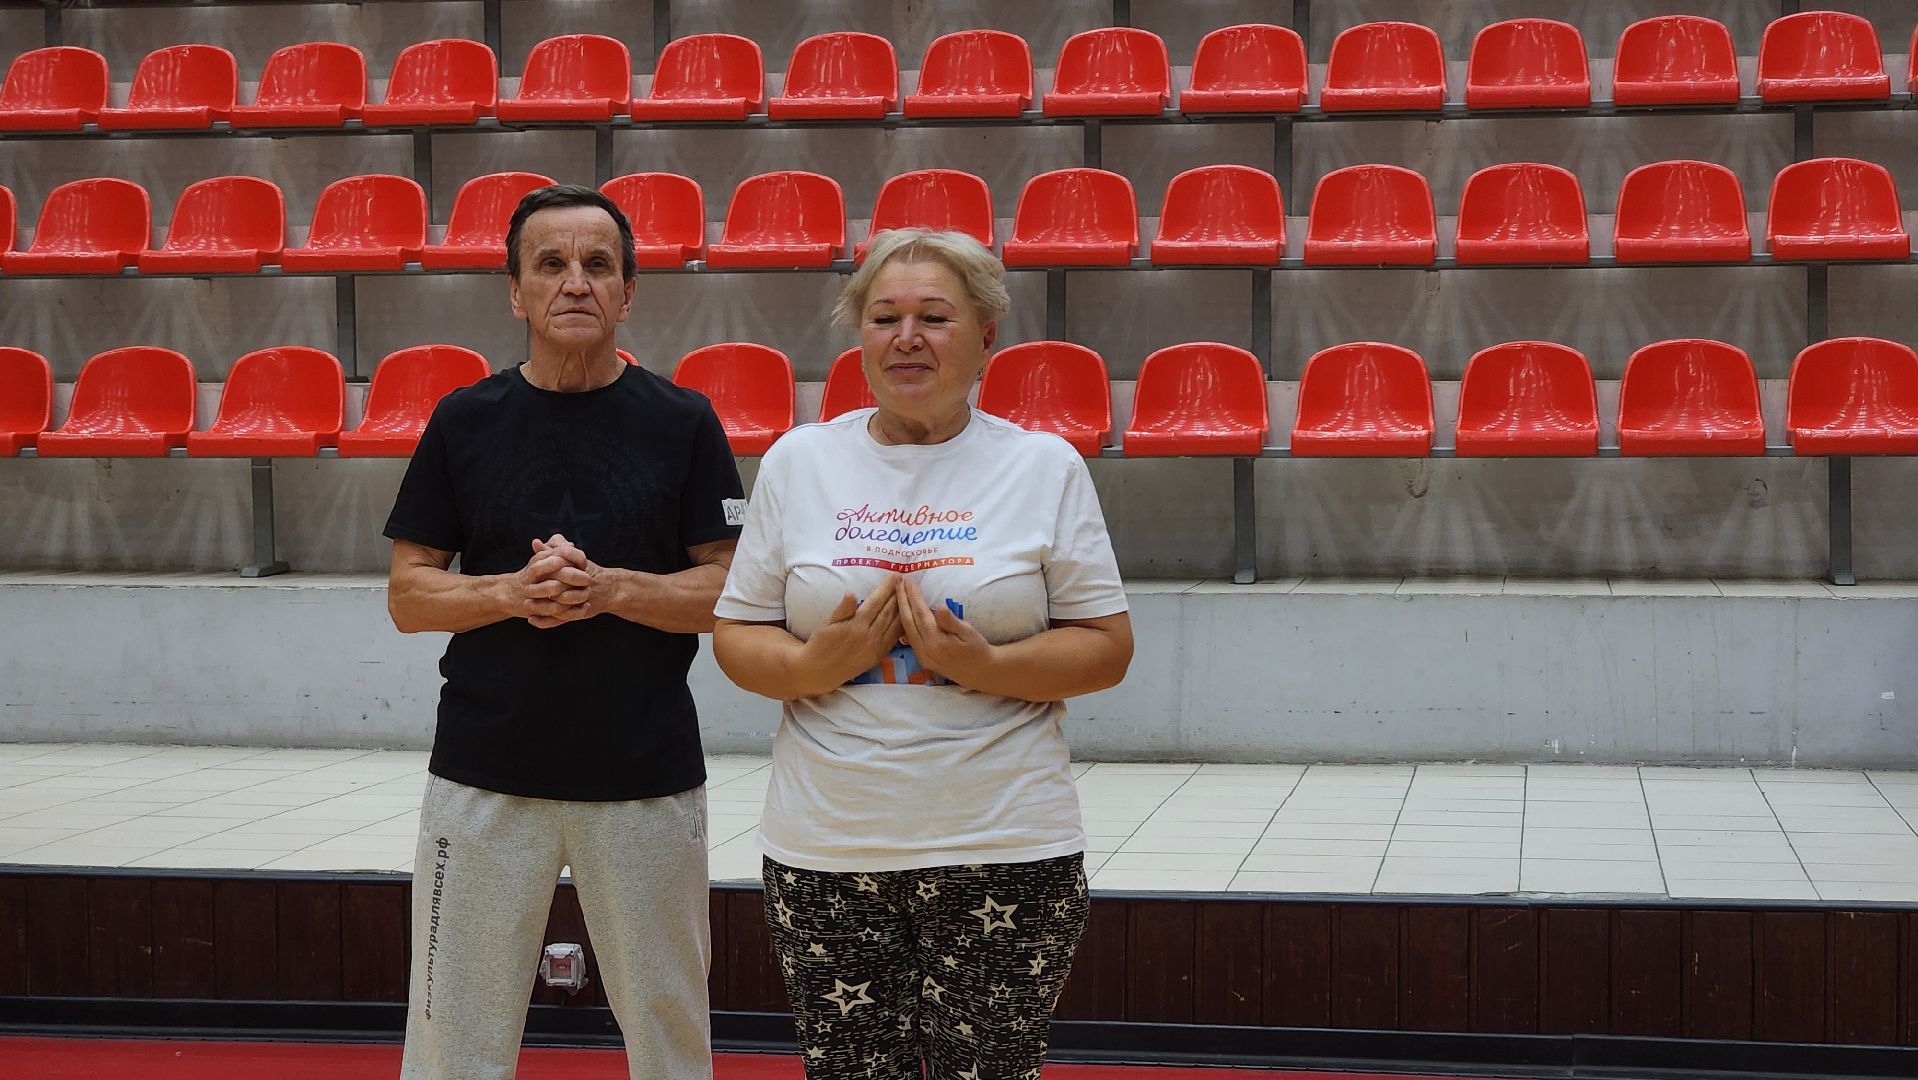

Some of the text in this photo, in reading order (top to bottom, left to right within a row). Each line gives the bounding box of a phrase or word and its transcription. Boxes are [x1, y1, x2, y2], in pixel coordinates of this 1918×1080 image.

[836, 503, 974, 526] Активное
[834, 519, 978, 546] долголетие
[891, 560, 972, 573] ГУБЕРНАТОРА
